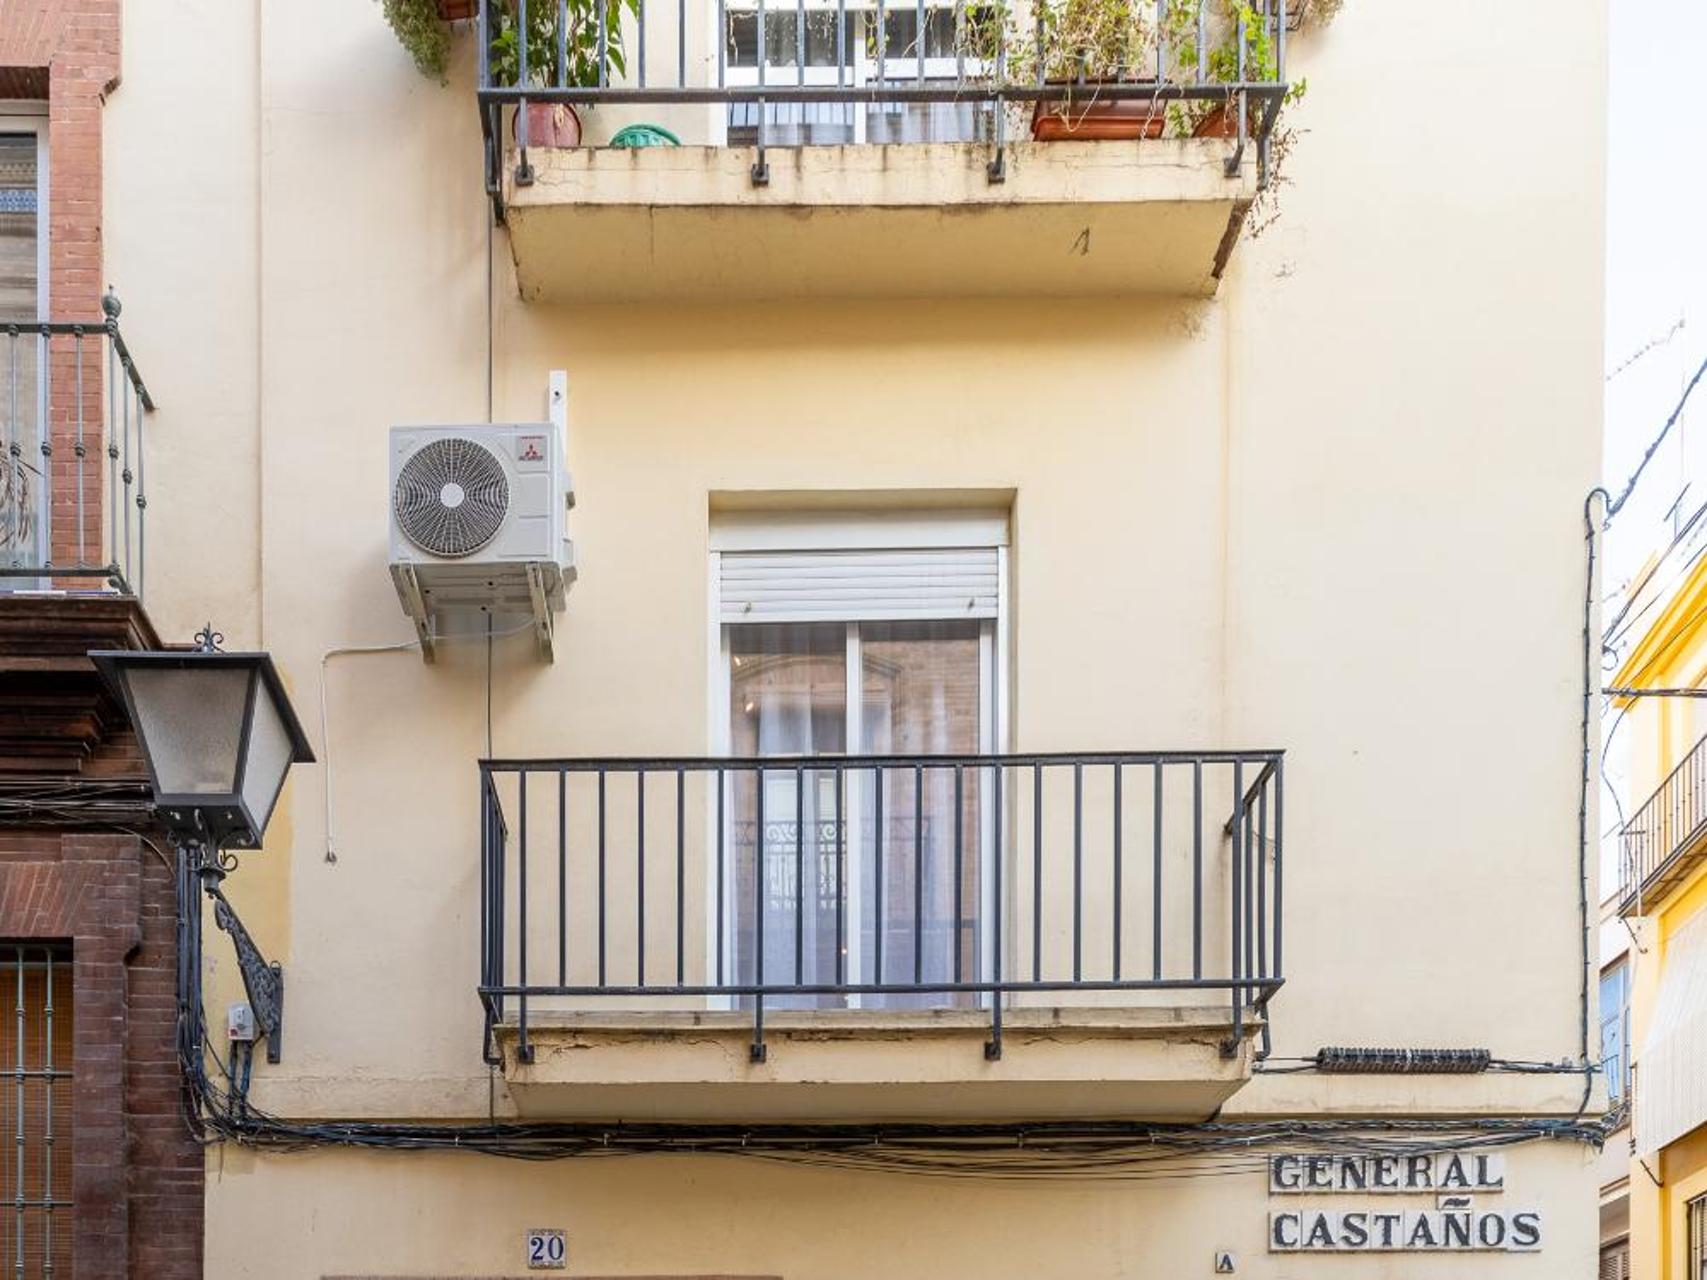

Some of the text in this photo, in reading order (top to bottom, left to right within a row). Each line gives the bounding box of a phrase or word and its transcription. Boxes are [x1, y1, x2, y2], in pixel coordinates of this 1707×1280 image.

[1273, 1154, 1503, 1187] GENERAL
[1273, 1197, 1541, 1246] CASTAÑOS
[531, 1236, 564, 1261] 20
[1219, 1254, 1234, 1270] A
